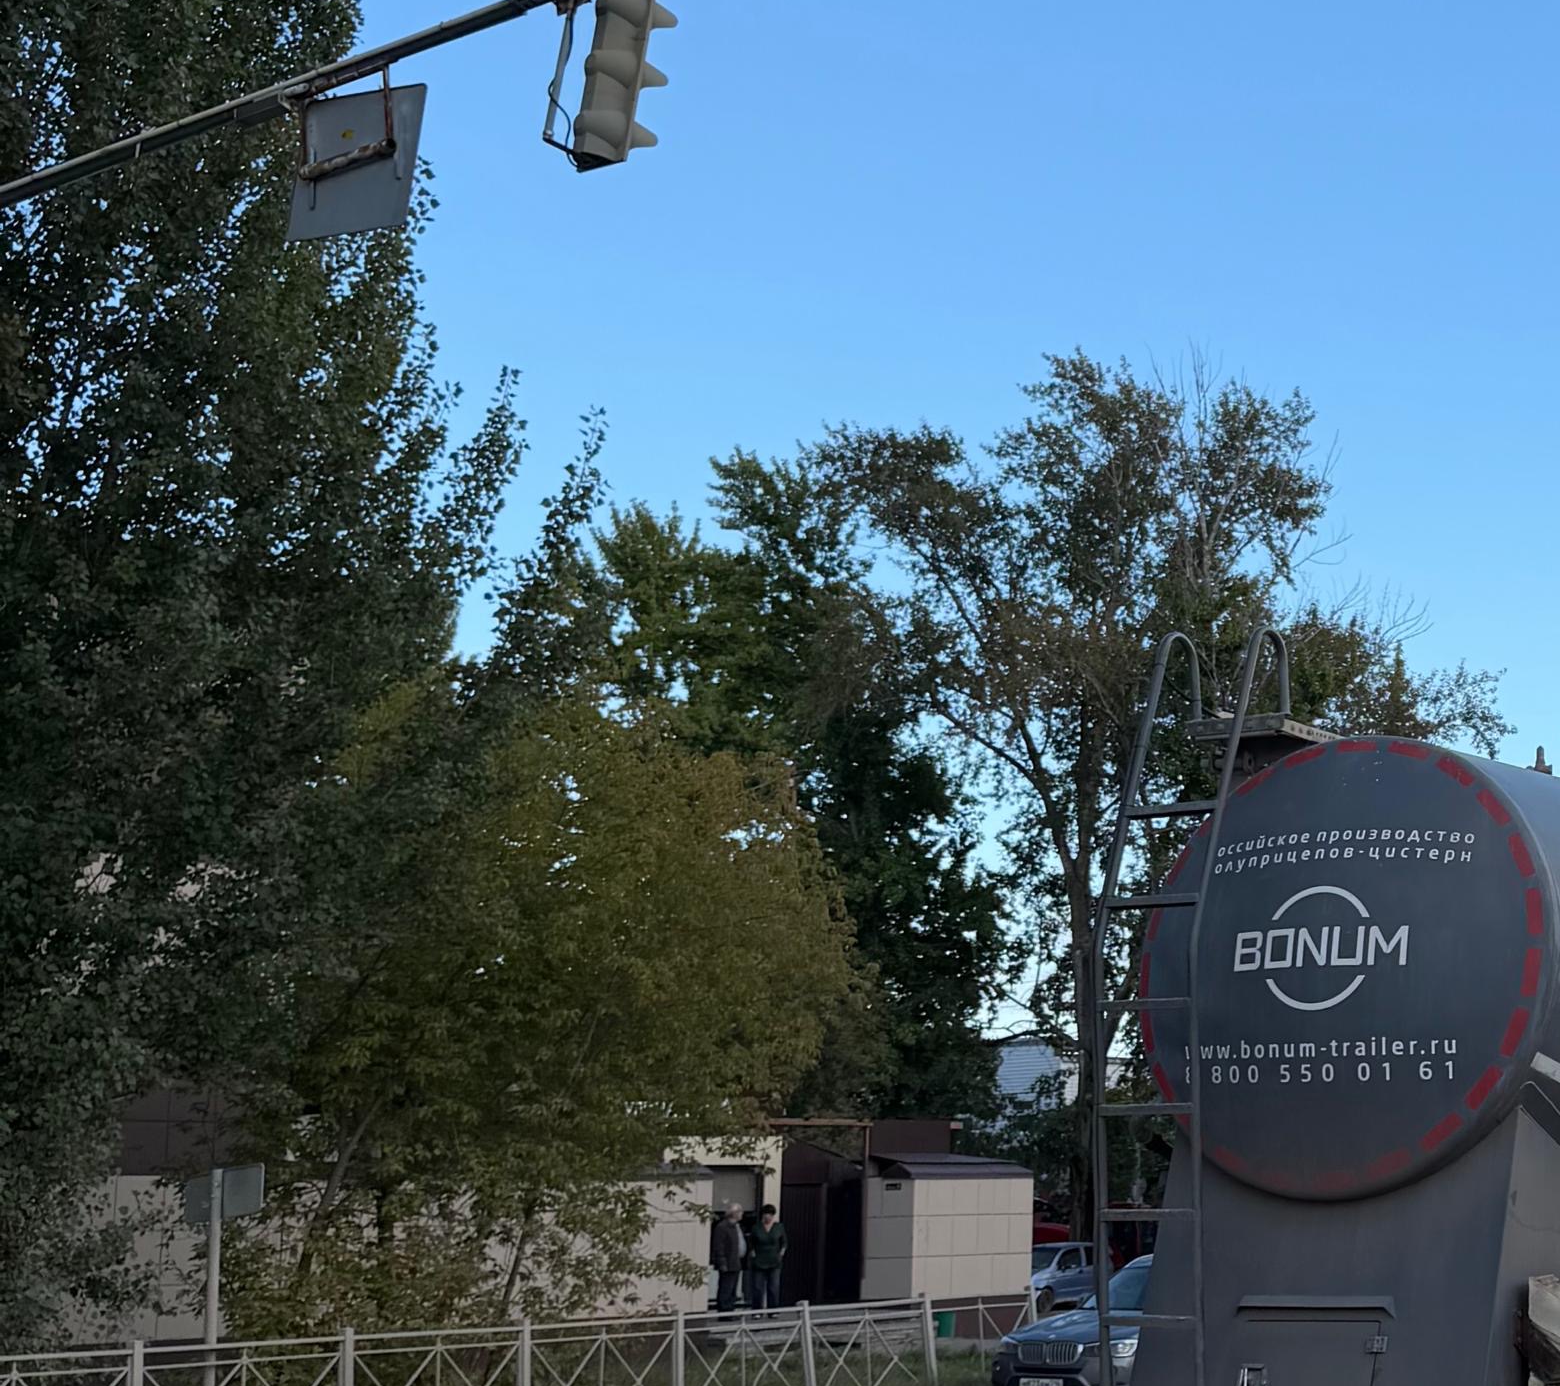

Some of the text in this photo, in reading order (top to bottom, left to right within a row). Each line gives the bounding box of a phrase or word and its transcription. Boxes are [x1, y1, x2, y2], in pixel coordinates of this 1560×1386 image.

[1216, 828, 1476, 858] оссийское производство
[1214, 846, 1473, 875] олуприцепов-цистерн
[1233, 924, 1410, 973] BONUM
[1185, 1036, 1458, 1060] ww.bonum-trailer.ru
[1211, 1064, 1259, 1084] 800
[1279, 1063, 1335, 1083] 550
[1357, 1061, 1391, 1082] 01
[1418, 1059, 1454, 1081] 61
